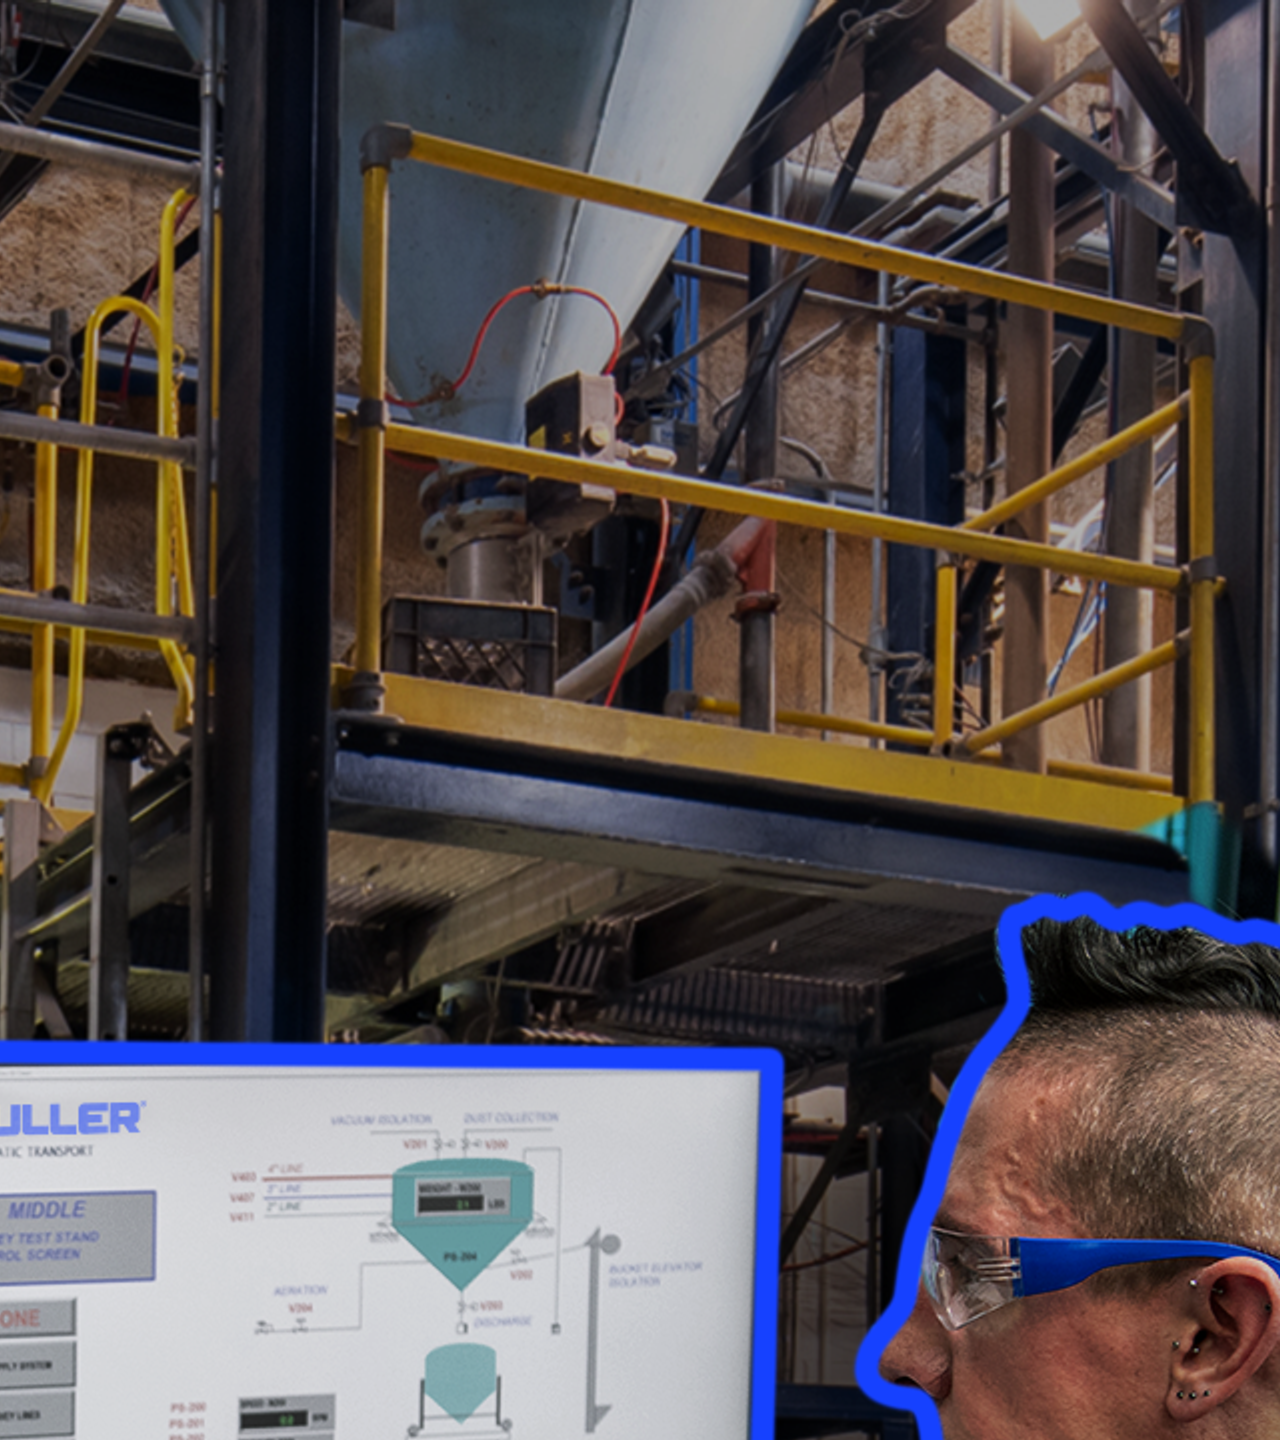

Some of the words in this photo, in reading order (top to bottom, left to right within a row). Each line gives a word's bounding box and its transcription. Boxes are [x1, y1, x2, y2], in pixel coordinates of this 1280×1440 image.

[331, 1114, 375, 1126] VACUUM
[378, 1113, 432, 1126] ISOLATION
[464, 1113, 492, 1124] DUST
[495, 1112, 560, 1124] COLLECTION
[28, 1145, 93, 1157] TRANSPORT
[281, 1163, 304, 1174] LINE
[280, 1183, 302, 1193] LINE
[7, 1200, 87, 1220] MIDDLE
[279, 1201, 302, 1212] LINE
[18, 1232, 52, 1245] TEST
[55, 1231, 100, 1244] STAND
[27, 1248, 81, 1262] SCREEN
[609, 1263, 652, 1274] BUCKET
[655, 1261, 703, 1273] ELEVATOR
[609, 1277, 661, 1288] ISOLATION
[274, 1285, 328, 1297] AERATION
[20, 1360, 52, 1371] SYSTEM
[17, 1410, 41, 1421] LINES
